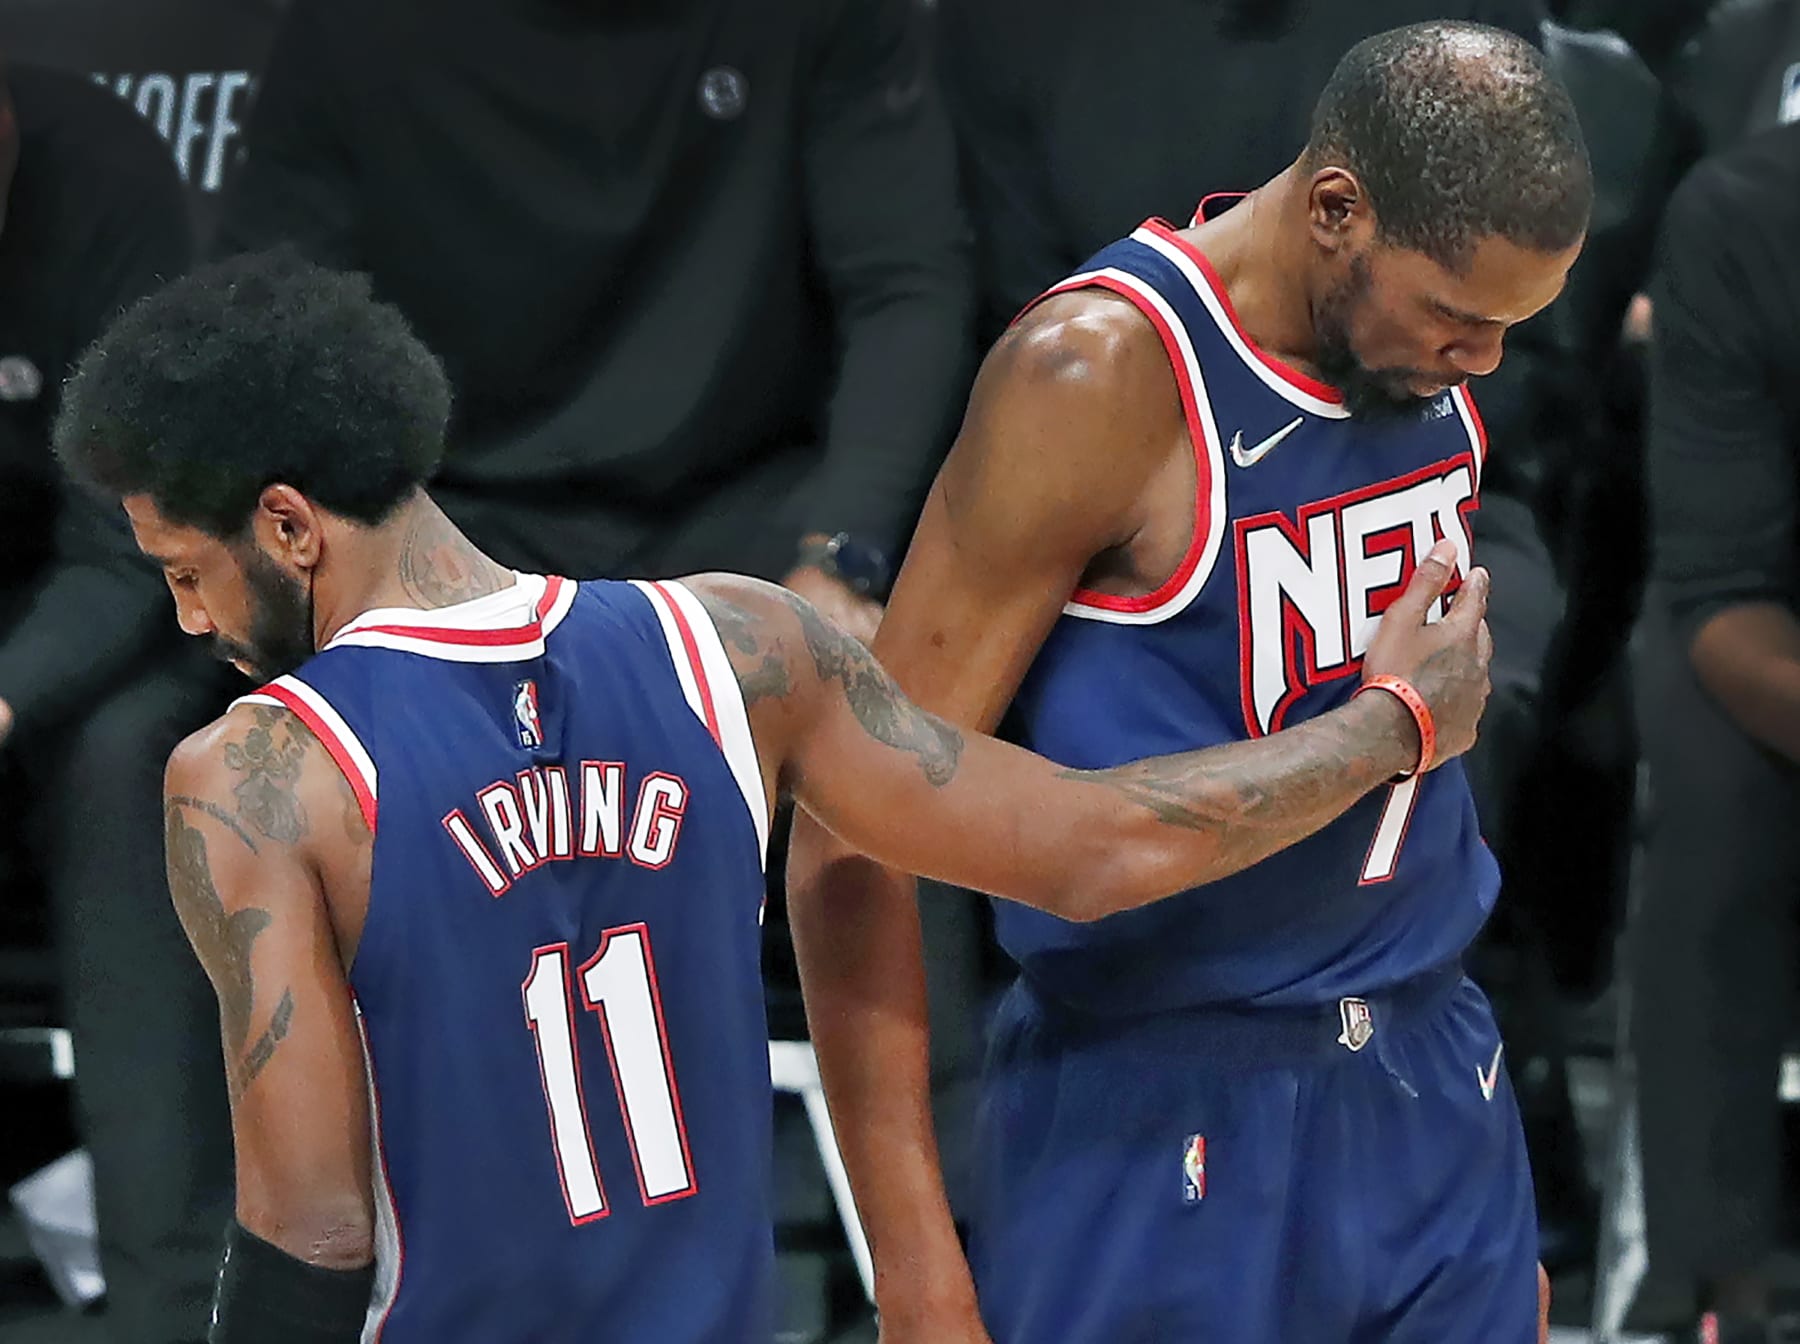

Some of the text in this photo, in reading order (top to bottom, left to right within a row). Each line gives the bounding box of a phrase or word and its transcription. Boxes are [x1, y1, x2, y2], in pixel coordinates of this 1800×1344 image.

[1233, 450, 1480, 740] NETS
[441, 760, 690, 897] IRVING
[521, 922, 698, 1226] 11
